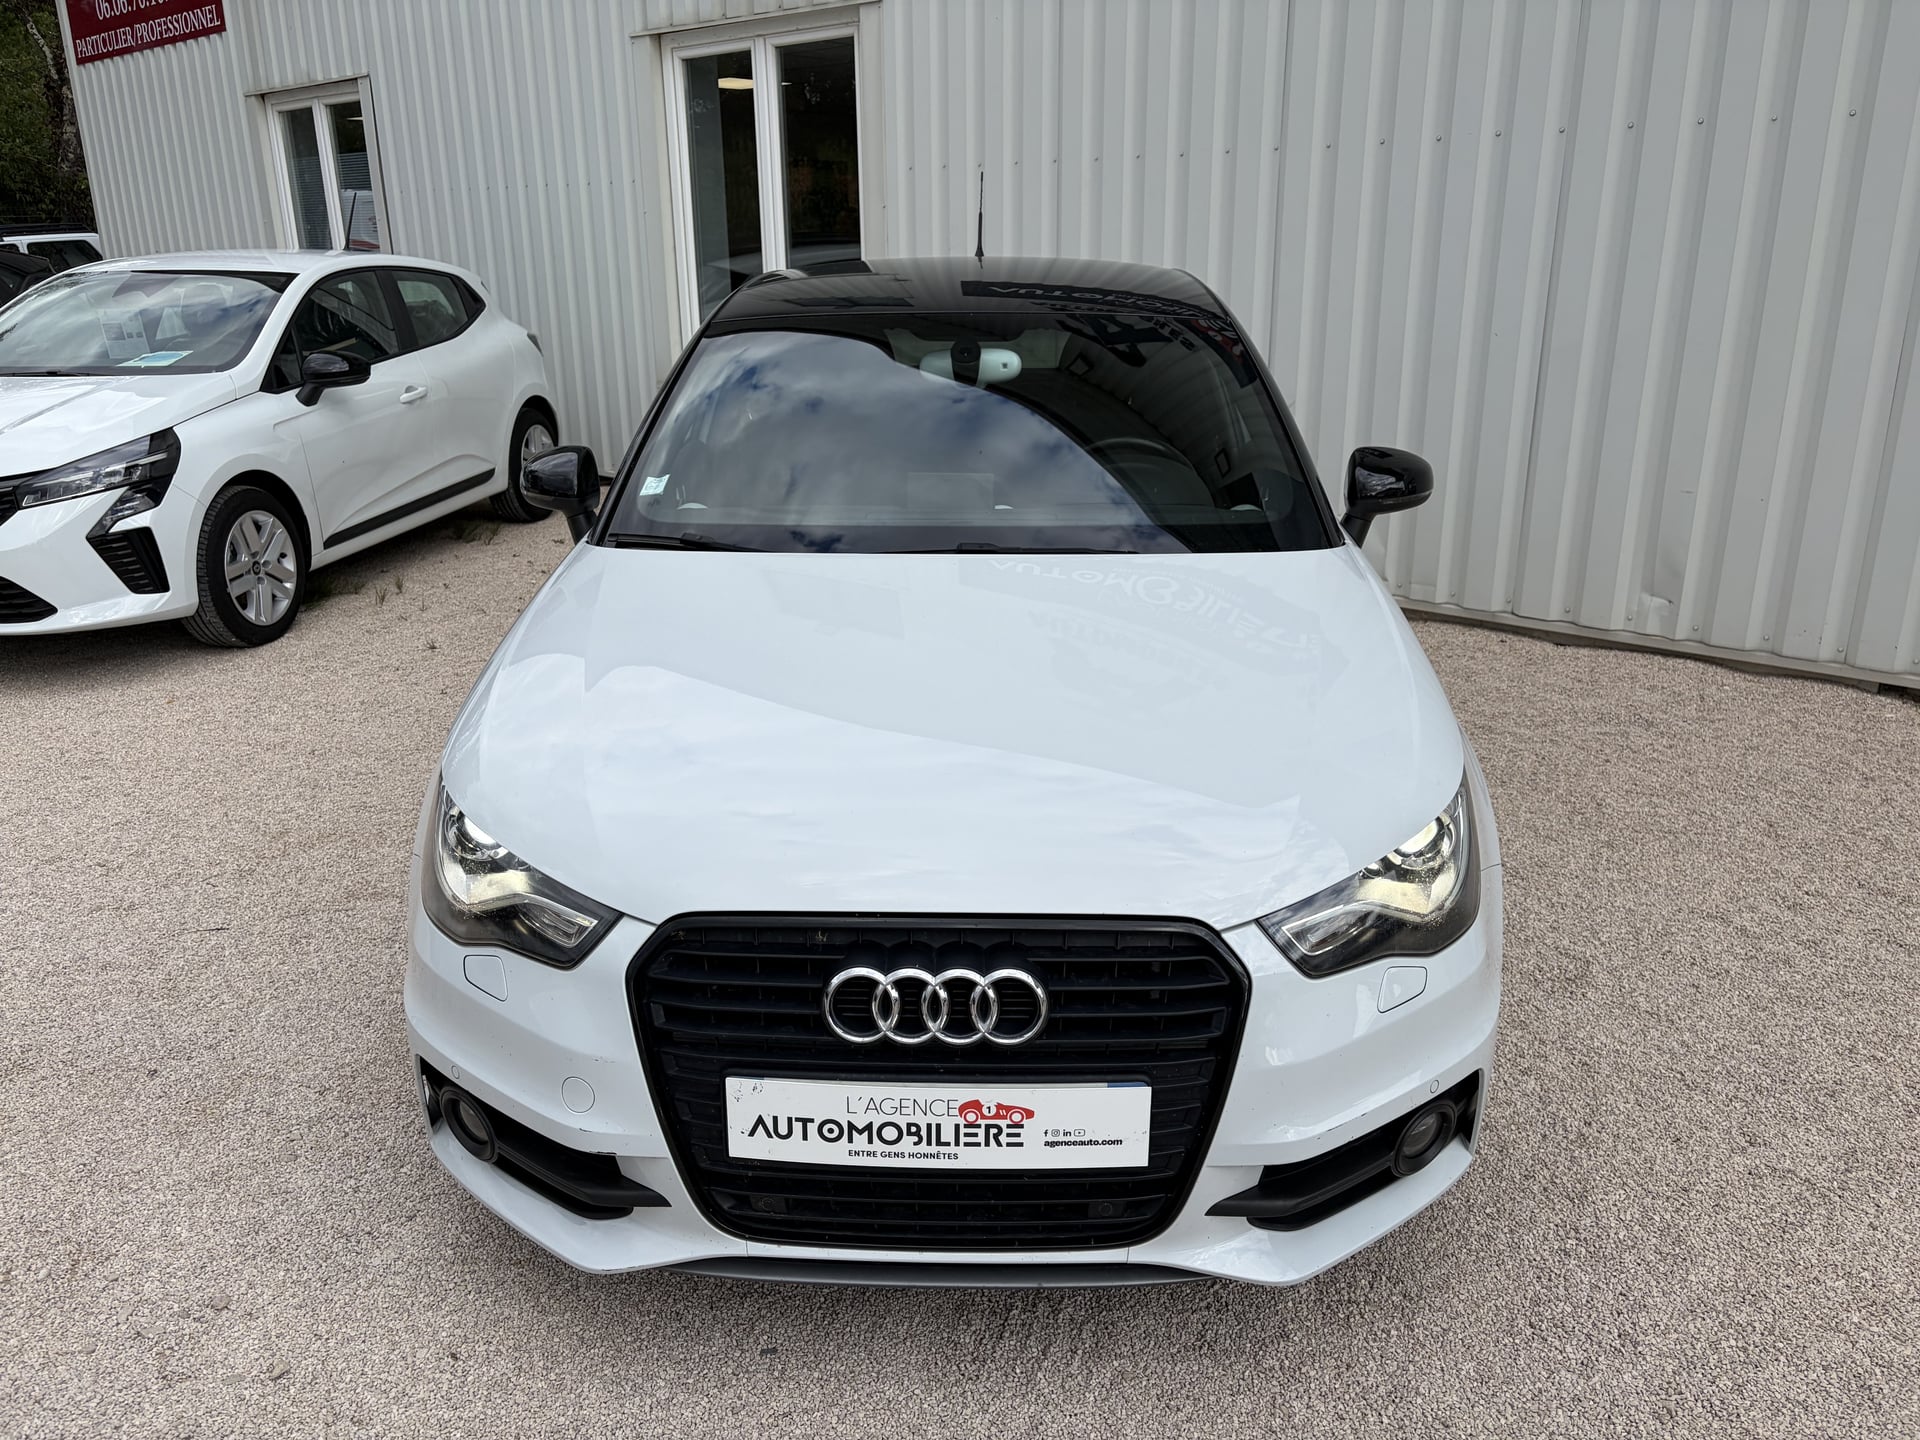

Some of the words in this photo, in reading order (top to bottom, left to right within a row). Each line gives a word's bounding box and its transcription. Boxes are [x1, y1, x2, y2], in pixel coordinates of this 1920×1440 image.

[75, 4, 221, 58] PARTICULIER/PROFESSIONNEL
[846, 1095, 959, 1117] L'AGENCE
[1043, 1138, 1123, 1148] agenceauto.com
[848, 1149, 878, 1158] ENTRE
[880, 1150, 906, 1159] GENS
[908, 1150, 959, 1160] HONNÊTES
